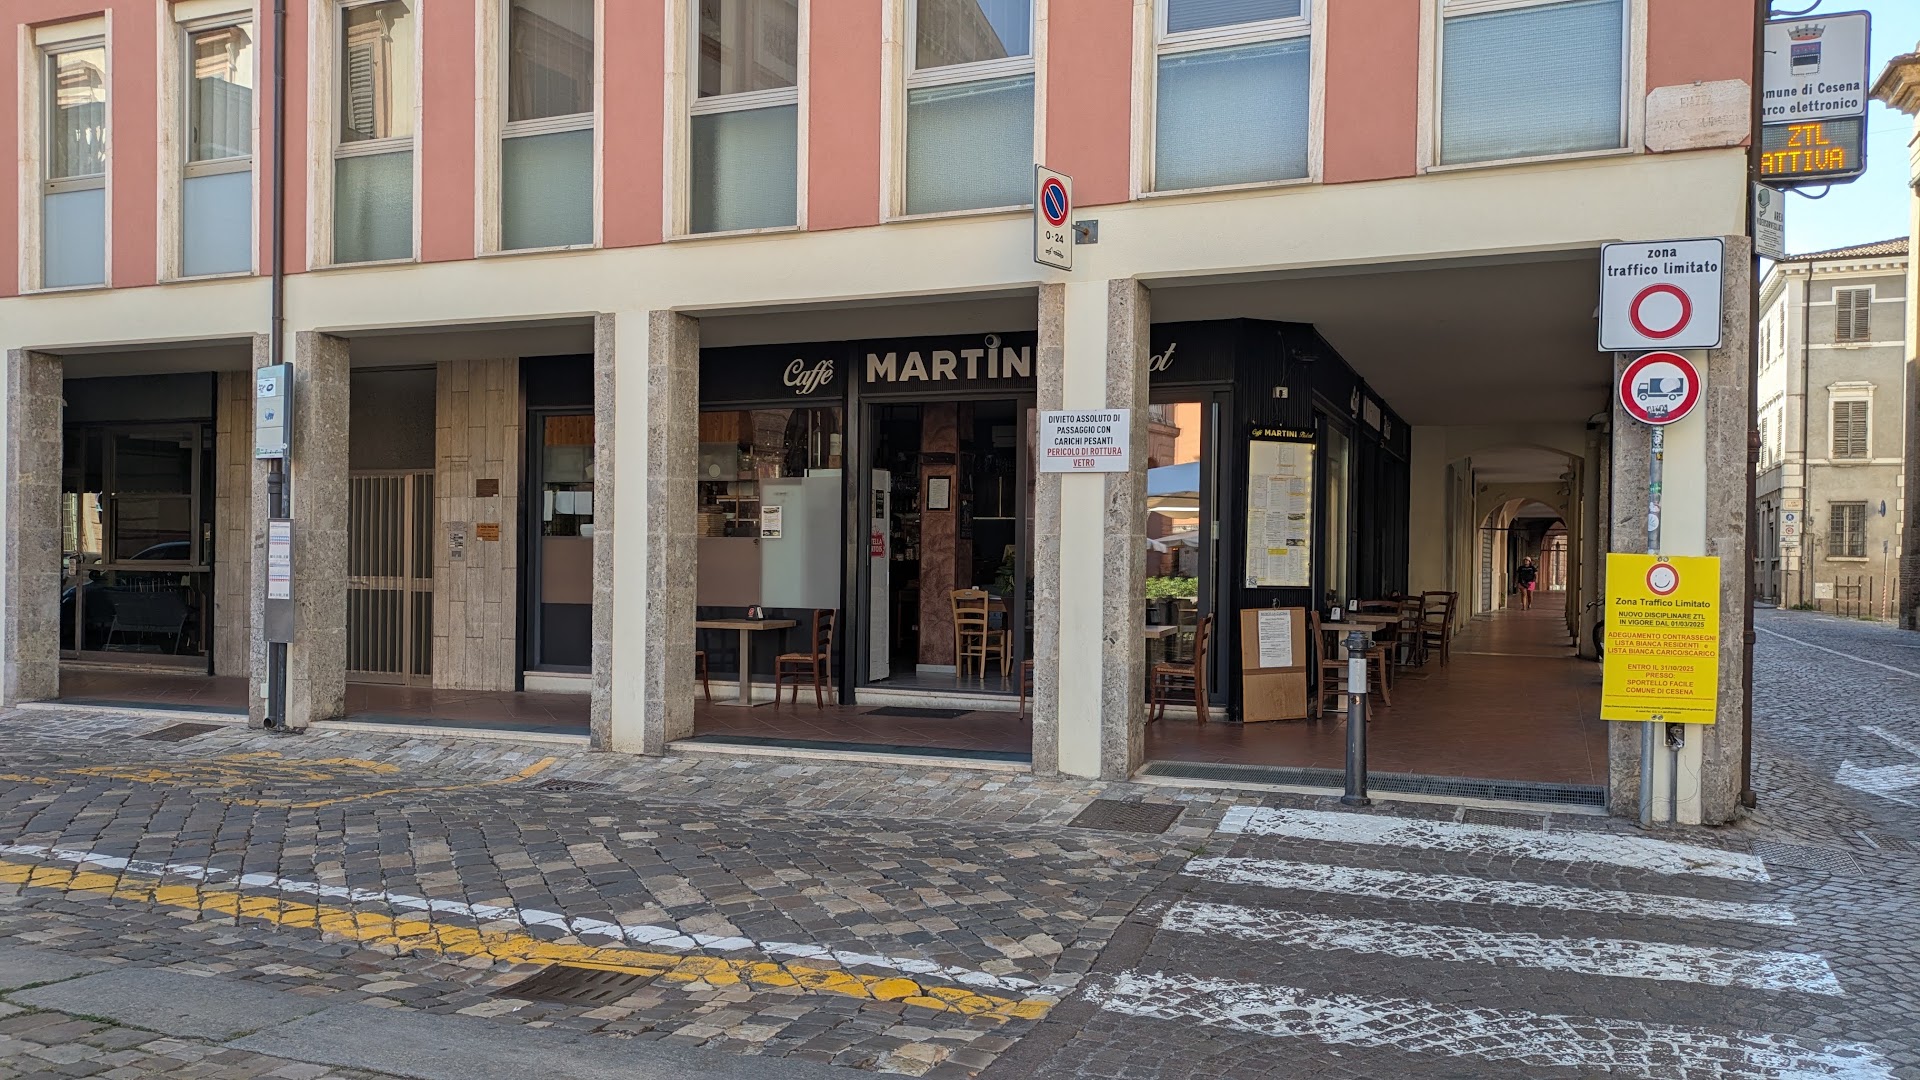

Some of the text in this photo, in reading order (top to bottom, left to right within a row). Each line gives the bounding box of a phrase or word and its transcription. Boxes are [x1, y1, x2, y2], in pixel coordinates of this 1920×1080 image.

[1763, 82, 1860, 98] mune di Cesena
[1763, 98, 1858, 115] arco elettronico
[1788, 124, 1829, 146] ZTL
[1761, 148, 1843, 174] ATTIVA
[1046, 230, 1064, 244] 0-24
[1648, 248, 1677, 258] zona
[1608, 260, 1717, 276] traffico limitato
[783, 358, 834, 395] Caffè
[866, 346, 1038, 383] MARTIN
[1048, 415, 1074, 423] DIVIETO
[1076, 414, 1111, 423] ASSOLUTO
[1057, 426, 1095, 434] PASSAGGIO
[1264, 429, 1297, 438] MARTINI
[1675, 600, 1710, 608] Limitato
